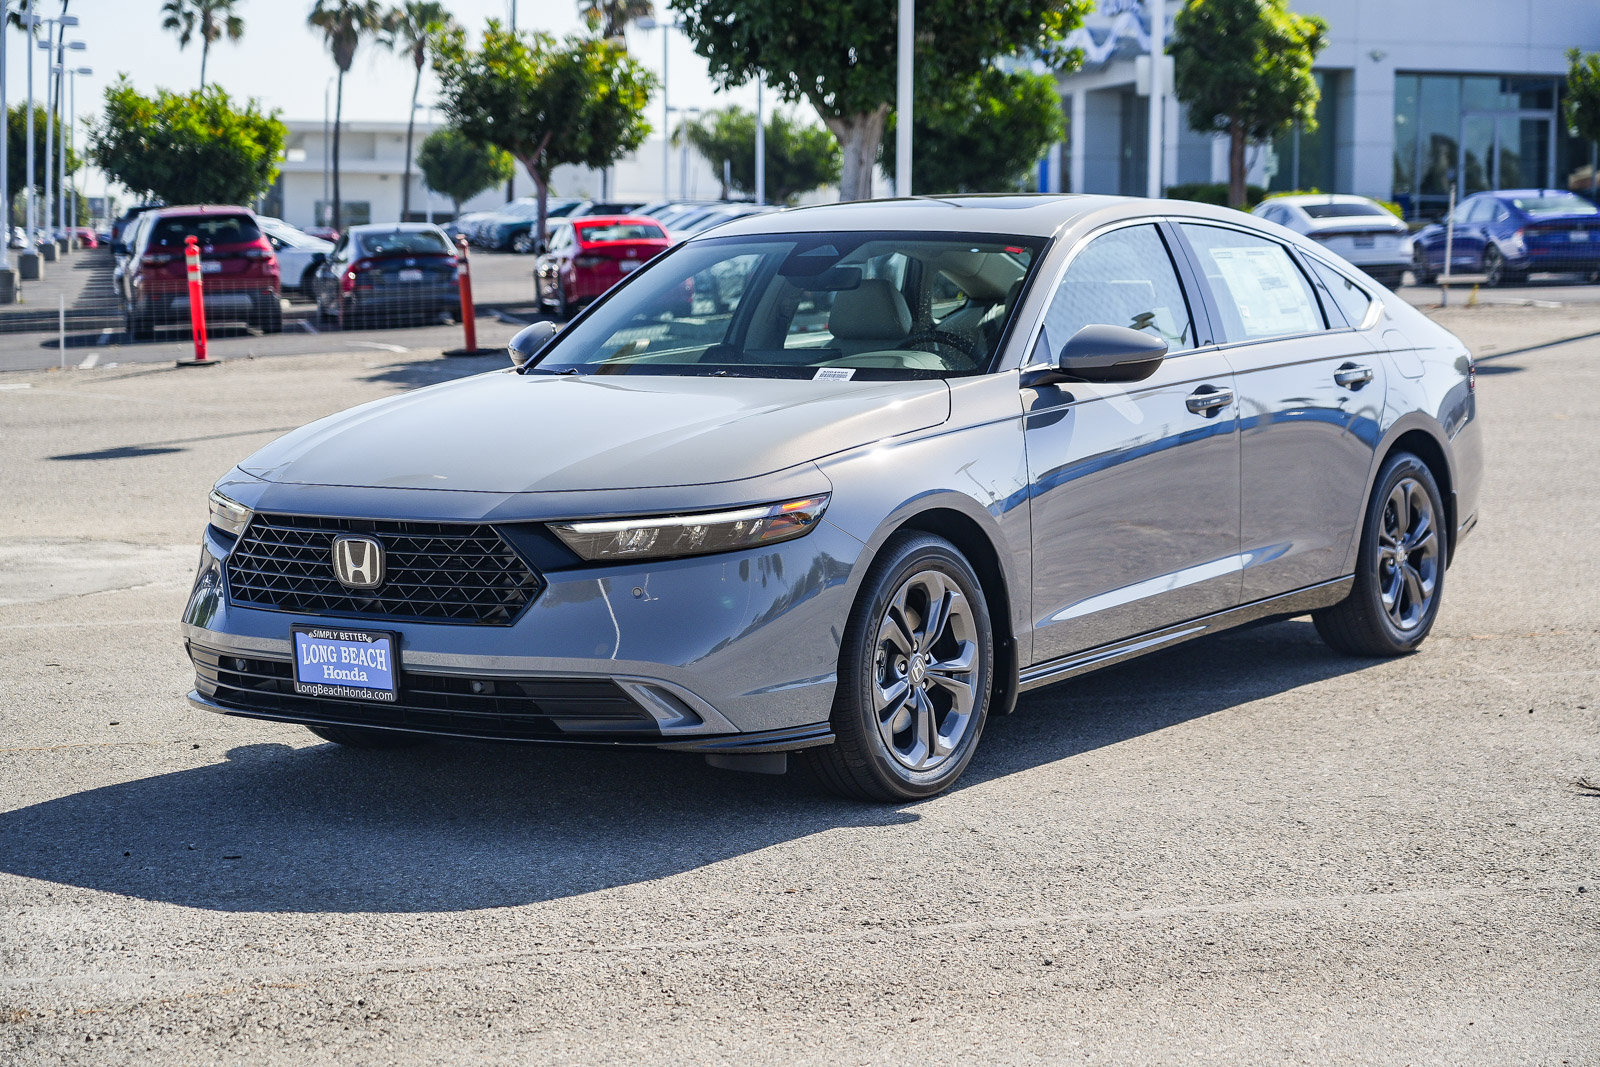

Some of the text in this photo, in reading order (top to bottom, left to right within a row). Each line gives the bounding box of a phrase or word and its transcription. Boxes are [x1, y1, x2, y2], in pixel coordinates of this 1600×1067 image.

[312, 629, 368, 642] SIMPLY BETTER
[302, 643, 387, 672] LONG BEACH
[322, 664, 369, 682] Honda
[296, 682, 393, 701] LongBeachHonda.com
